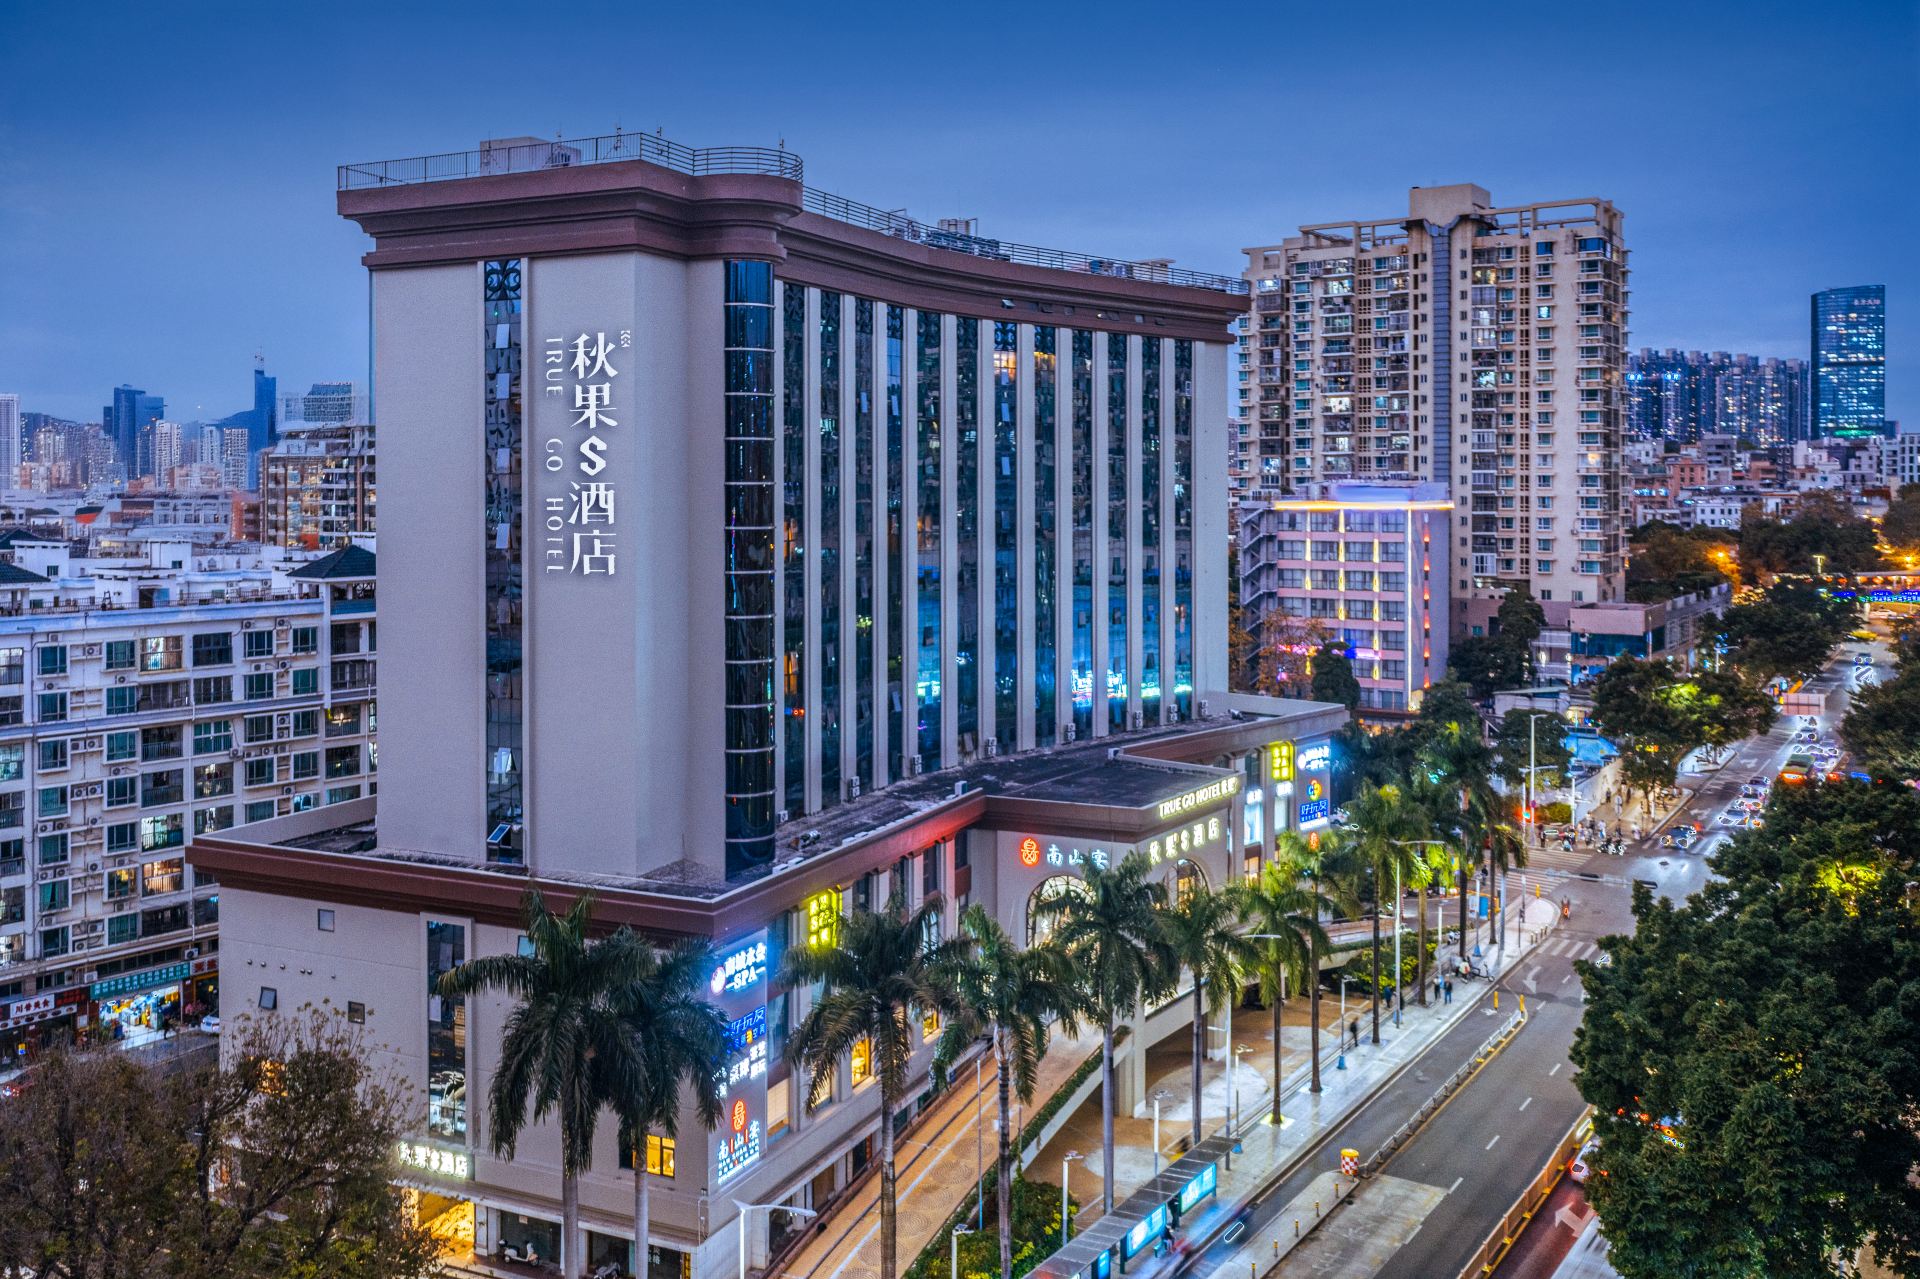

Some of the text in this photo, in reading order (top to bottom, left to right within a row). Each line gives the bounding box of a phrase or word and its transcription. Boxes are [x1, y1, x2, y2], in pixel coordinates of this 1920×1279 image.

[545, 438, 564, 472] GO
[567, 332, 619, 576] 秋果S酒店
[545, 497, 564, 574] HOTEL
[1158, 797, 1182, 818] TRUE
[1182, 793, 1196, 810] GO
[1196, 783, 1221, 804] HOTEL
